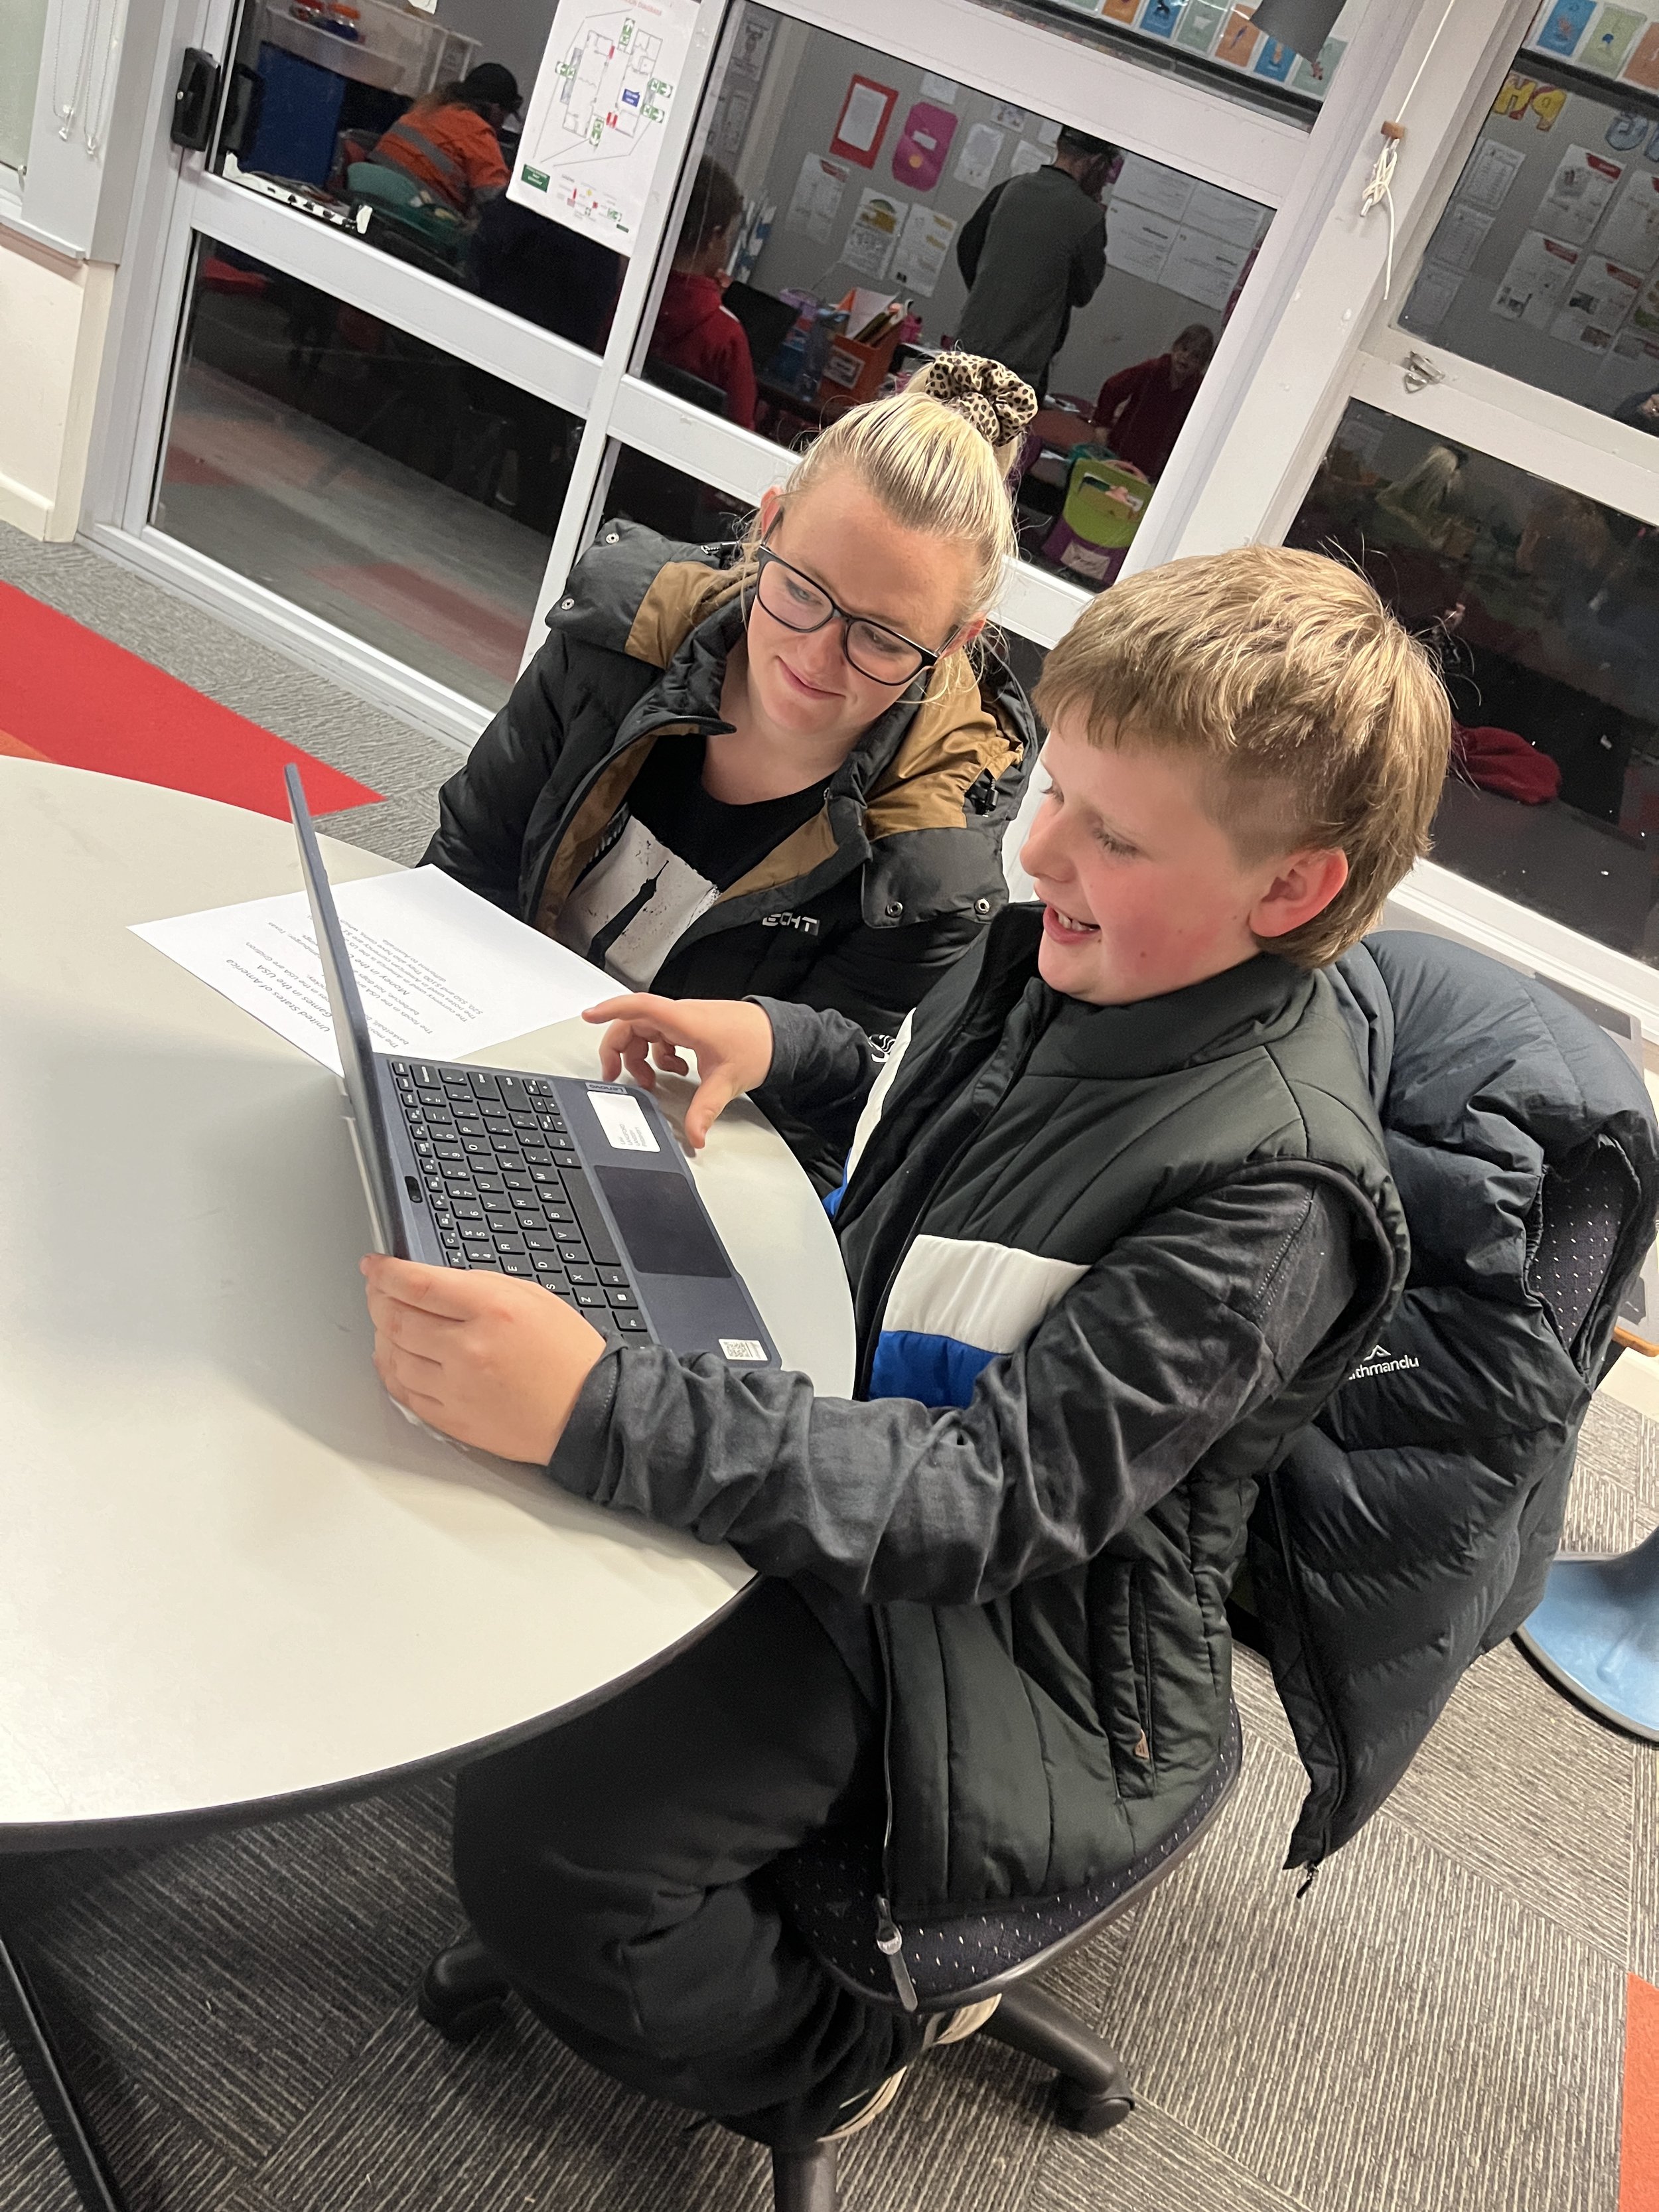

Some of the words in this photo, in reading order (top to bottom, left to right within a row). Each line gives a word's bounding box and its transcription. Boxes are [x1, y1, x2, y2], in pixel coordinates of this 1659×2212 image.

[267, 922, 286, 934] Texas
[358, 948, 370, 957] the
[362, 944, 392, 962] currency
[376, 944, 394, 956] have
[354, 958, 370, 968] the
[392, 954, 407, 964] also
[226, 959, 263, 984] America
[257, 964, 276, 978] USA
[283, 969, 299, 980] USA
[376, 960, 403, 978] America
[390, 962, 422, 982] American
[405, 964, 422, 975] They
[276, 978, 293, 990] the
[358, 973, 375, 984] dogs
[298, 980, 311, 989] the
[373, 984, 387, 993] hot
[378, 975, 410, 995] Money
[408, 983, 427, 994] used
[365, 988, 381, 999] USA
[427, 987, 445, 997] used
[272, 992, 301, 1011] States
[301, 997, 333, 1017] Games
[380, 998, 393, 1007] the
[426, 994, 456, 1013] currency
[445, 997, 465, 1011] notes
[400, 1011, 420, 1025] foods
[455, 1013, 468, 1022] The
[463, 1010, 476, 1019] The
[297, 1011, 330, 1032] United
[419, 1025, 433, 1034] The
[384, 1038, 399, 1049] The
